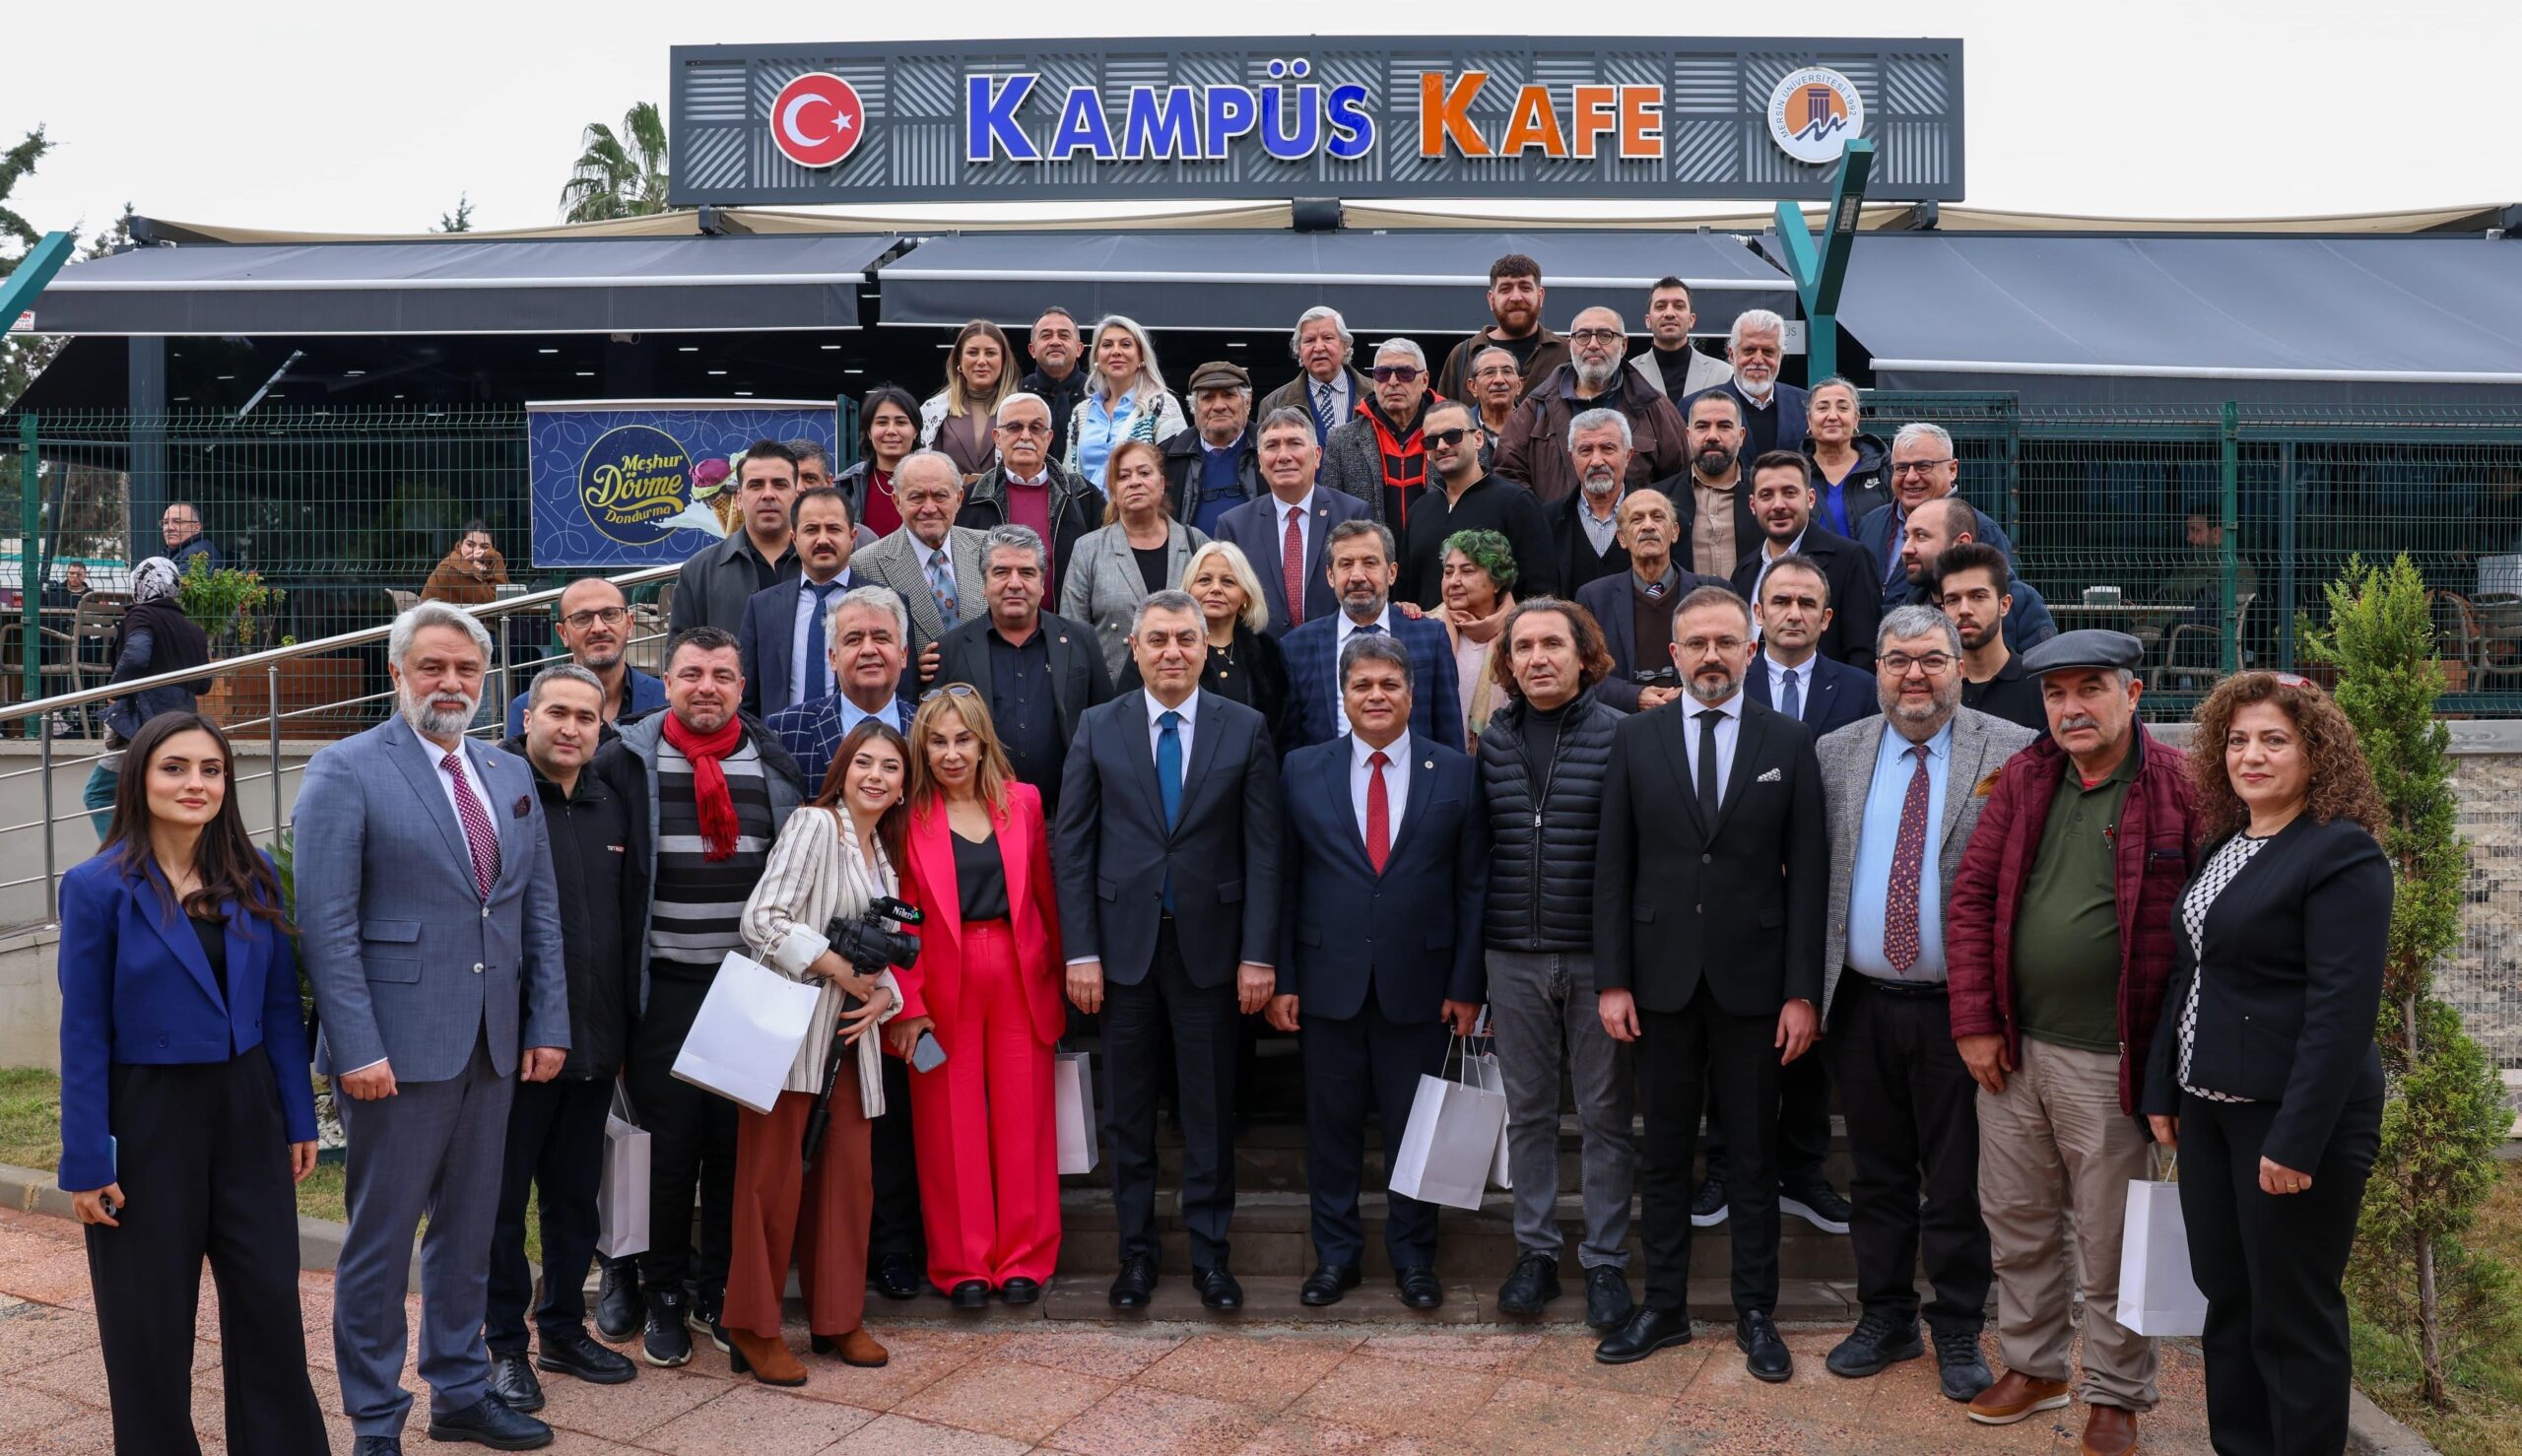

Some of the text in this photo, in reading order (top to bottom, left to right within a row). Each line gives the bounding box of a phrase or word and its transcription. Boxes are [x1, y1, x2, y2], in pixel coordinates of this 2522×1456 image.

[965, 57, 1664, 163] KAMPÜS KAFE
[1774, 74, 1858, 139] MERSİN ÜNİVERSİTESİ 1992
[621, 454, 684, 473] Meşhur
[585, 464, 685, 507] Dövme
[604, 505, 672, 524] Dondurma
